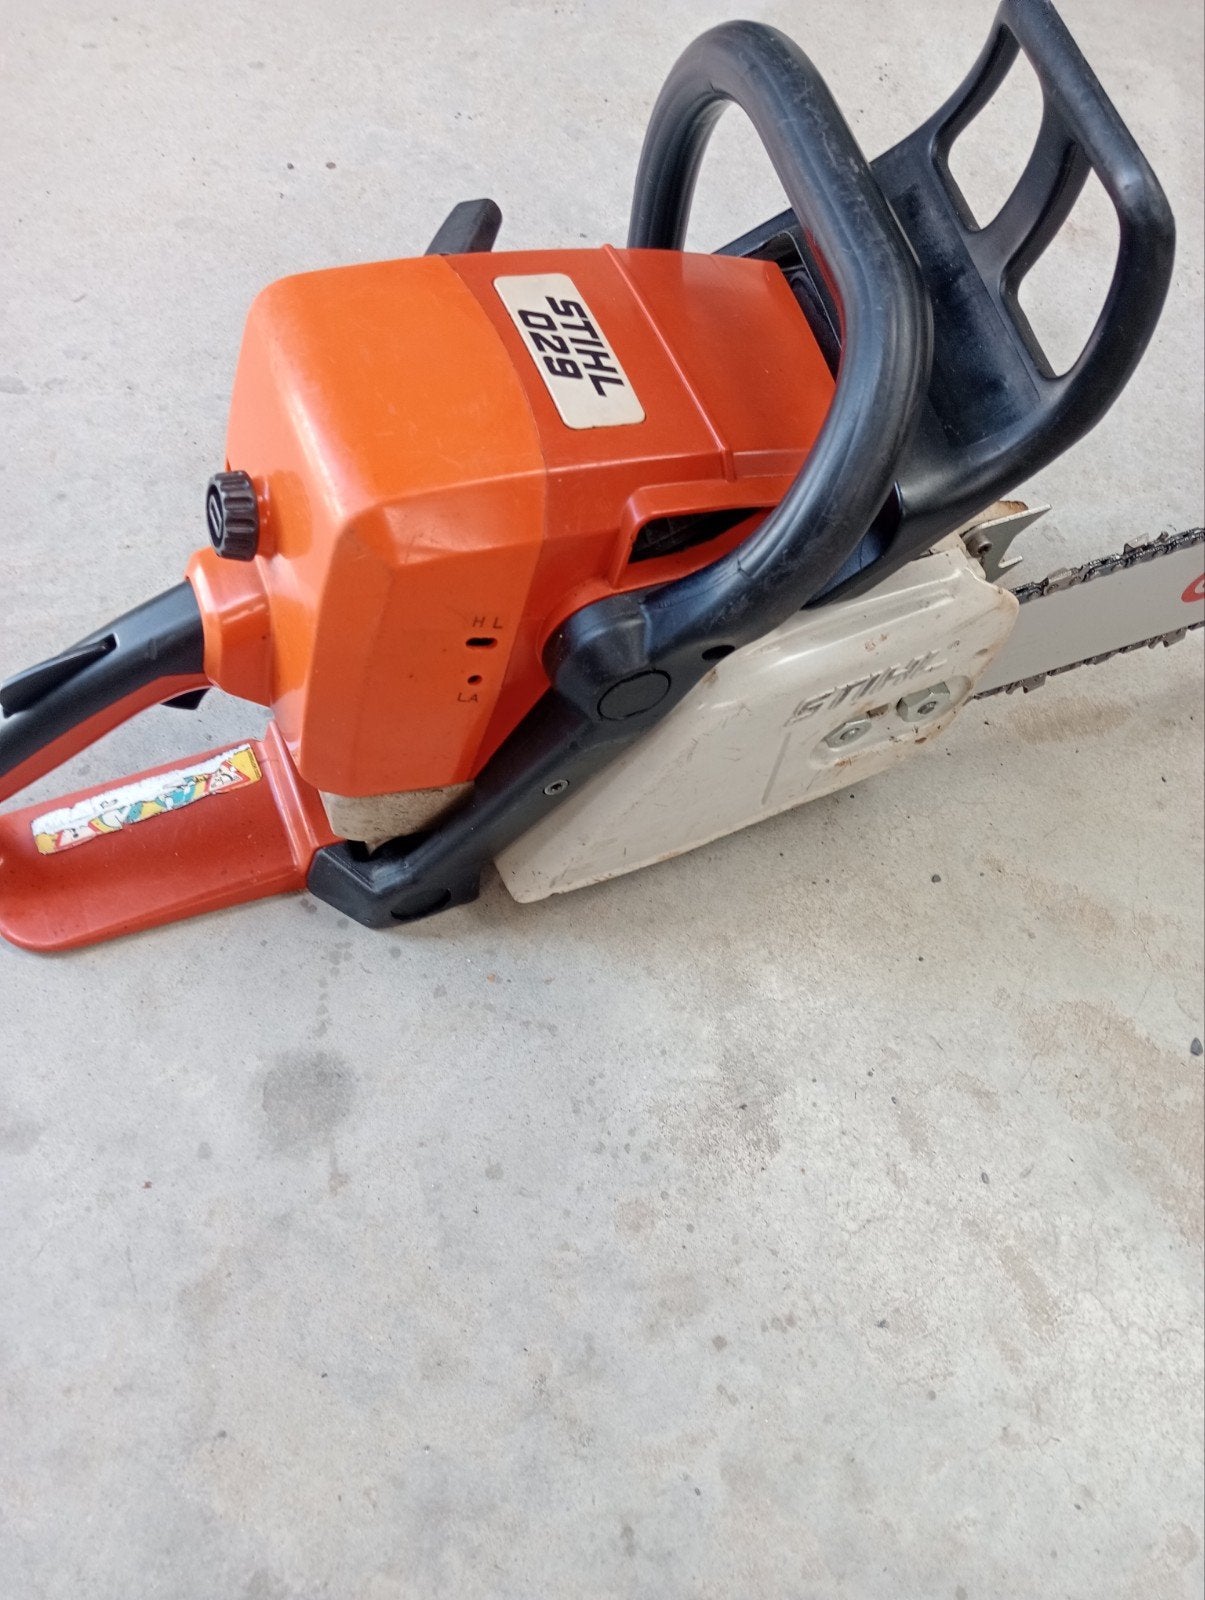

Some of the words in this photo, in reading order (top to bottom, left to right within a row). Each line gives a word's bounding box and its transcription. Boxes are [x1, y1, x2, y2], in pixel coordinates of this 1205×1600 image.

[517, 309, 583, 379] 029
[545, 296, 625, 397] STIHL
[472, 616, 485, 628] H
[492, 617, 503, 629] L
[786, 650, 948, 725] STIHL
